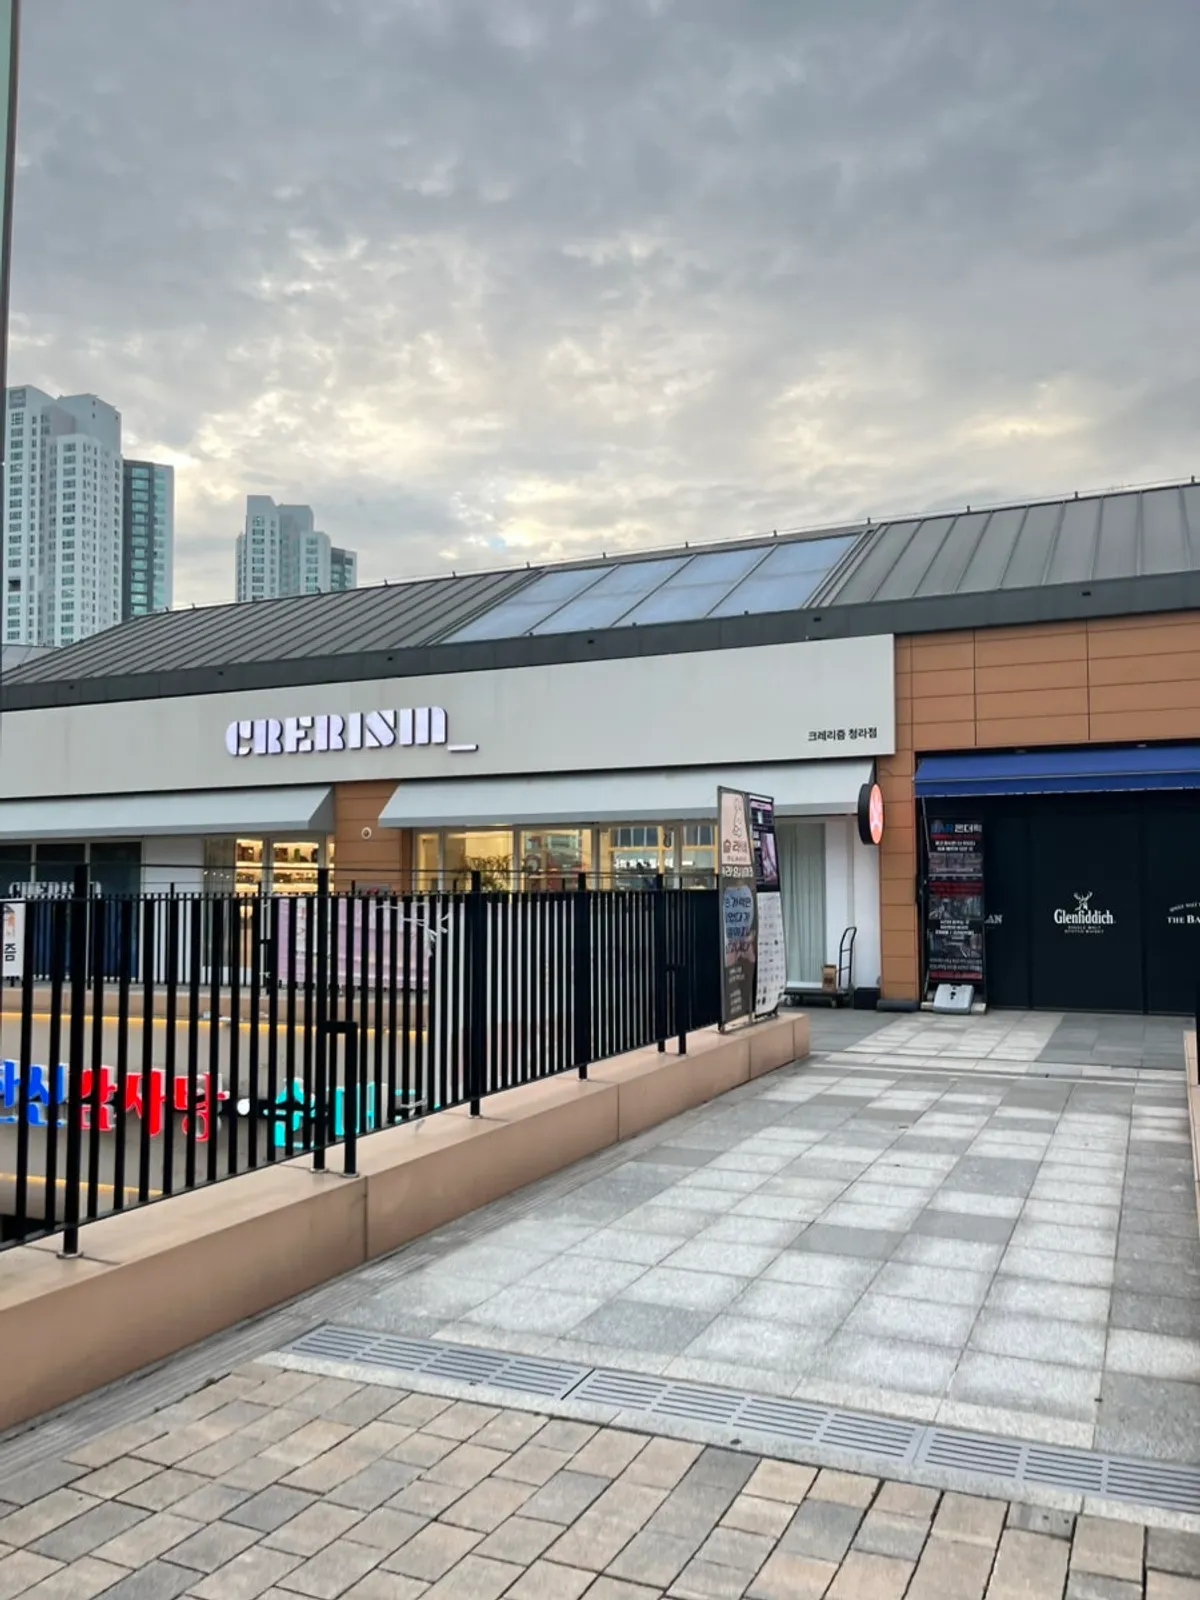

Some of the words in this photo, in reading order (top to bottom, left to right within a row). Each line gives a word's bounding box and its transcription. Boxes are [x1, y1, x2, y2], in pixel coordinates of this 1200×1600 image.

[807, 729, 846, 742] 크레리즘
[848, 727, 878, 740] 청라점
[1053, 908, 1114, 924] Glenfiddich
